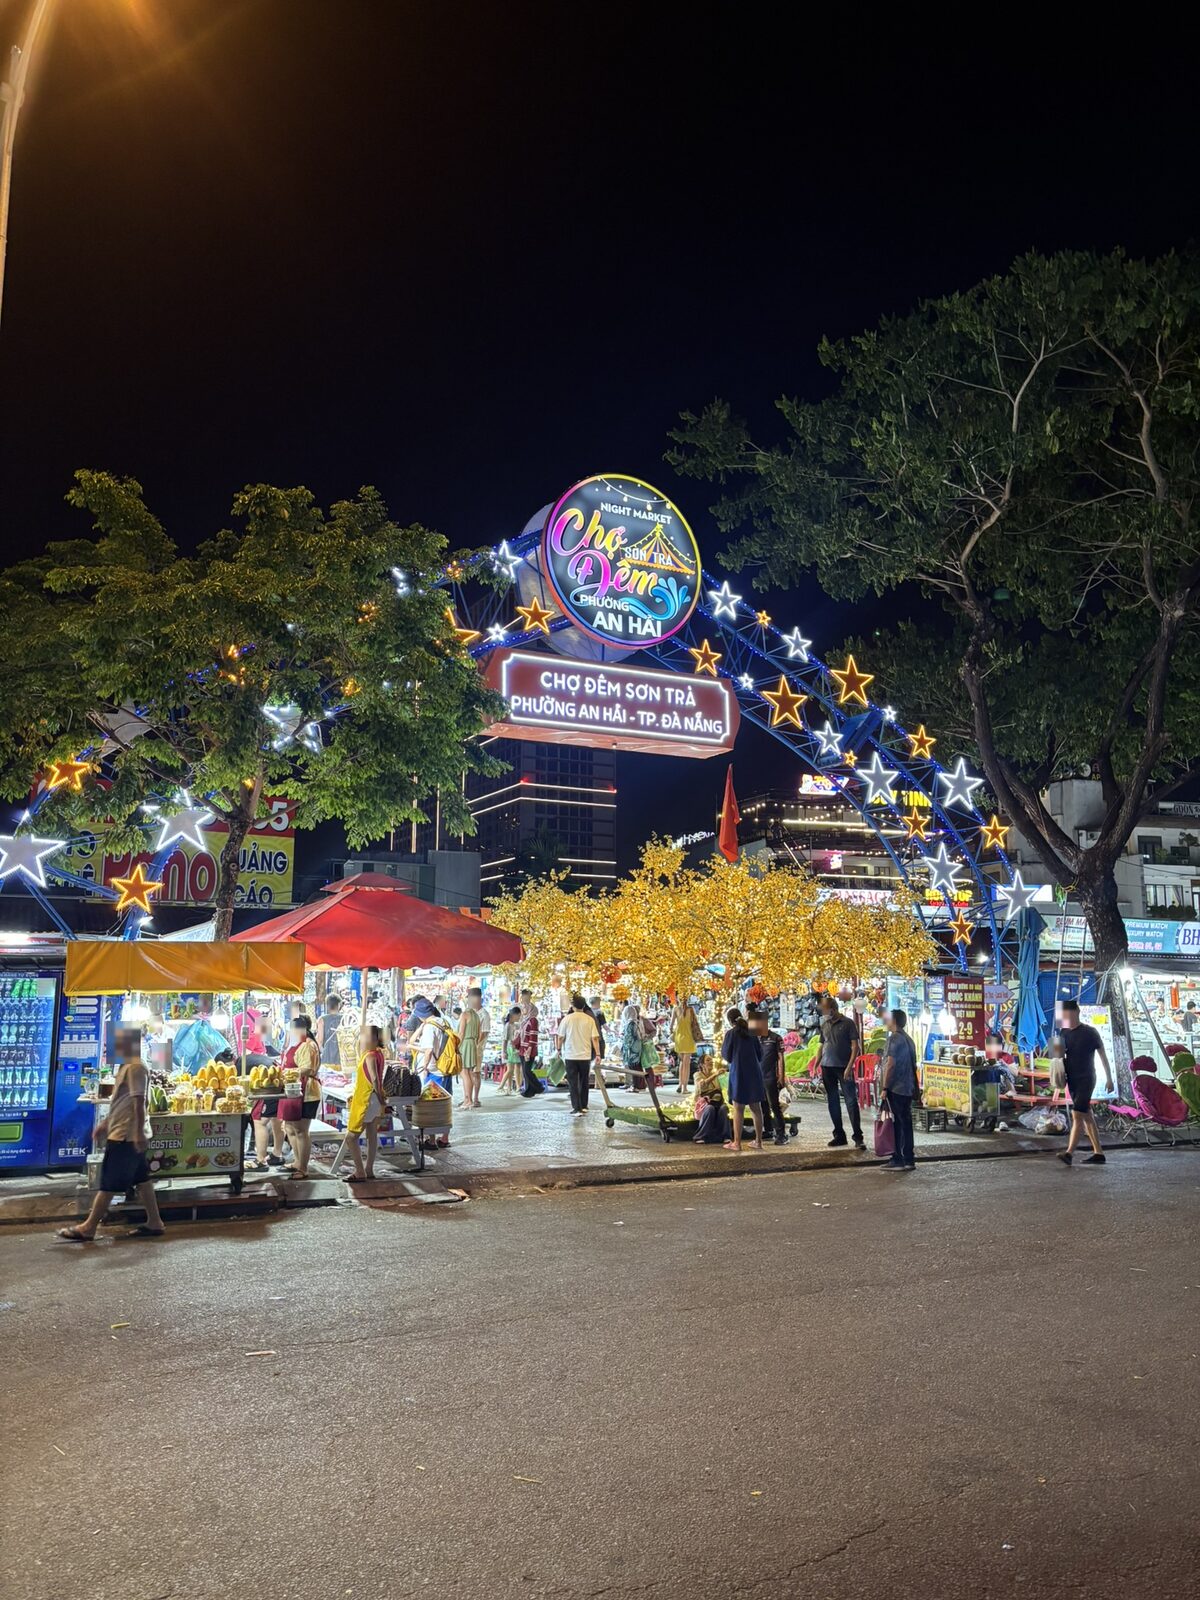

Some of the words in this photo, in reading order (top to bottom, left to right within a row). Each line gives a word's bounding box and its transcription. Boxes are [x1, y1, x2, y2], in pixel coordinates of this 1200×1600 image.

[600, 502, 632, 517] NIGHT
[633, 509, 673, 525] MARKET
[551, 507, 628, 560] Chợ
[567, 549, 659, 600] Đêm
[580, 594, 631, 612] PHƯỜNG
[592, 611, 623, 632] AN
[628, 614, 662, 638] HẢI
[540, 671, 581, 696] CHỢ
[584, 673, 621, 697] ĐÊM
[625, 682, 661, 702] SƠN
[665, 685, 697, 706] TRÀ
[511, 695, 576, 717] PHƯỜNG
[578, 703, 600, 720] AN
[603, 703, 627, 723] HẢI
[637, 711, 659, 727] TP.
[661, 711, 682, 729] ĐÀ
[235, 881, 274, 904] CÁO
[959, 1021, 973, 1035] 2-9
[201, 1120, 228, 1136] 망고
[58, 1147, 87, 1156] ETEK
[149, 1140, 182, 1149] GOSTEEN
[197, 1137, 231, 1148] MANGO
